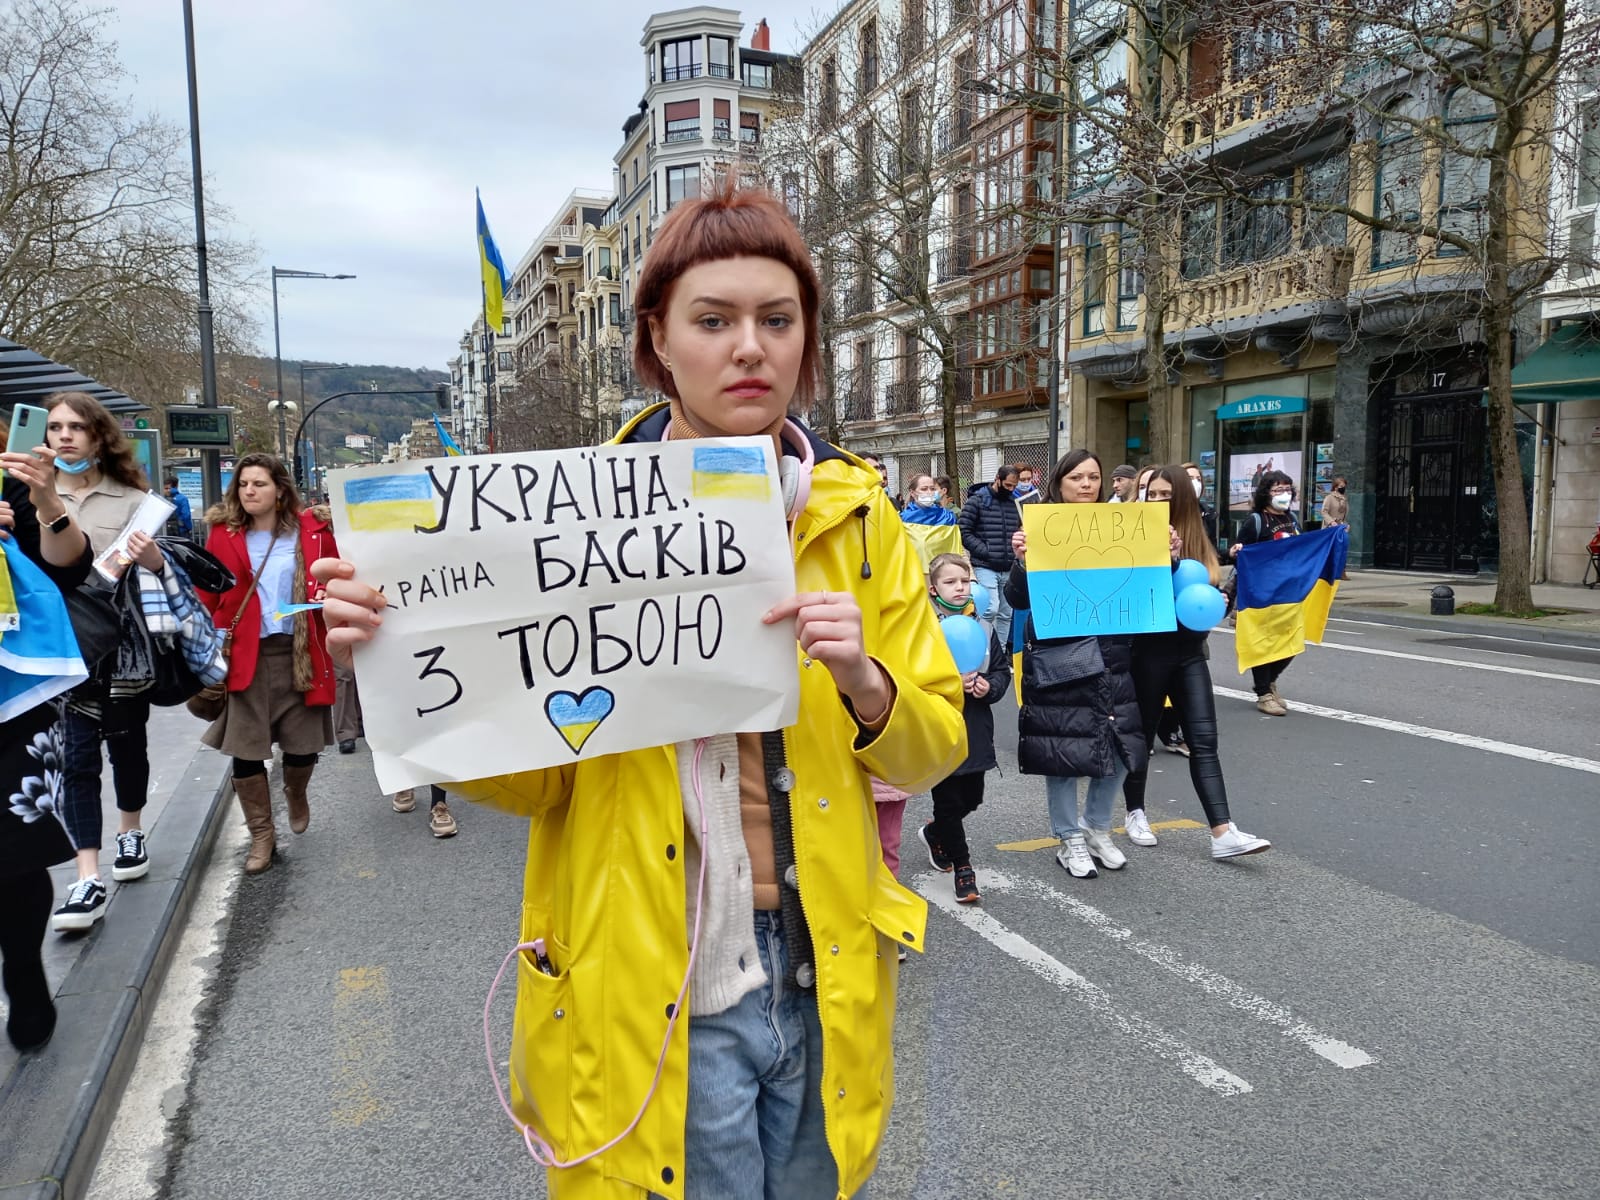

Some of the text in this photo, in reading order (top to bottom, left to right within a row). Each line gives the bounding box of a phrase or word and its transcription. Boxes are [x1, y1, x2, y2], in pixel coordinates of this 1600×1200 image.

[1432, 373, 1446, 387] 17
[1236, 400, 1282, 414] ARAXES
[414, 452, 690, 534] УКРАЇНА,
[1043, 510, 1147, 546] СЛАВА
[413, 594, 723, 718] З ТОБОЮ
